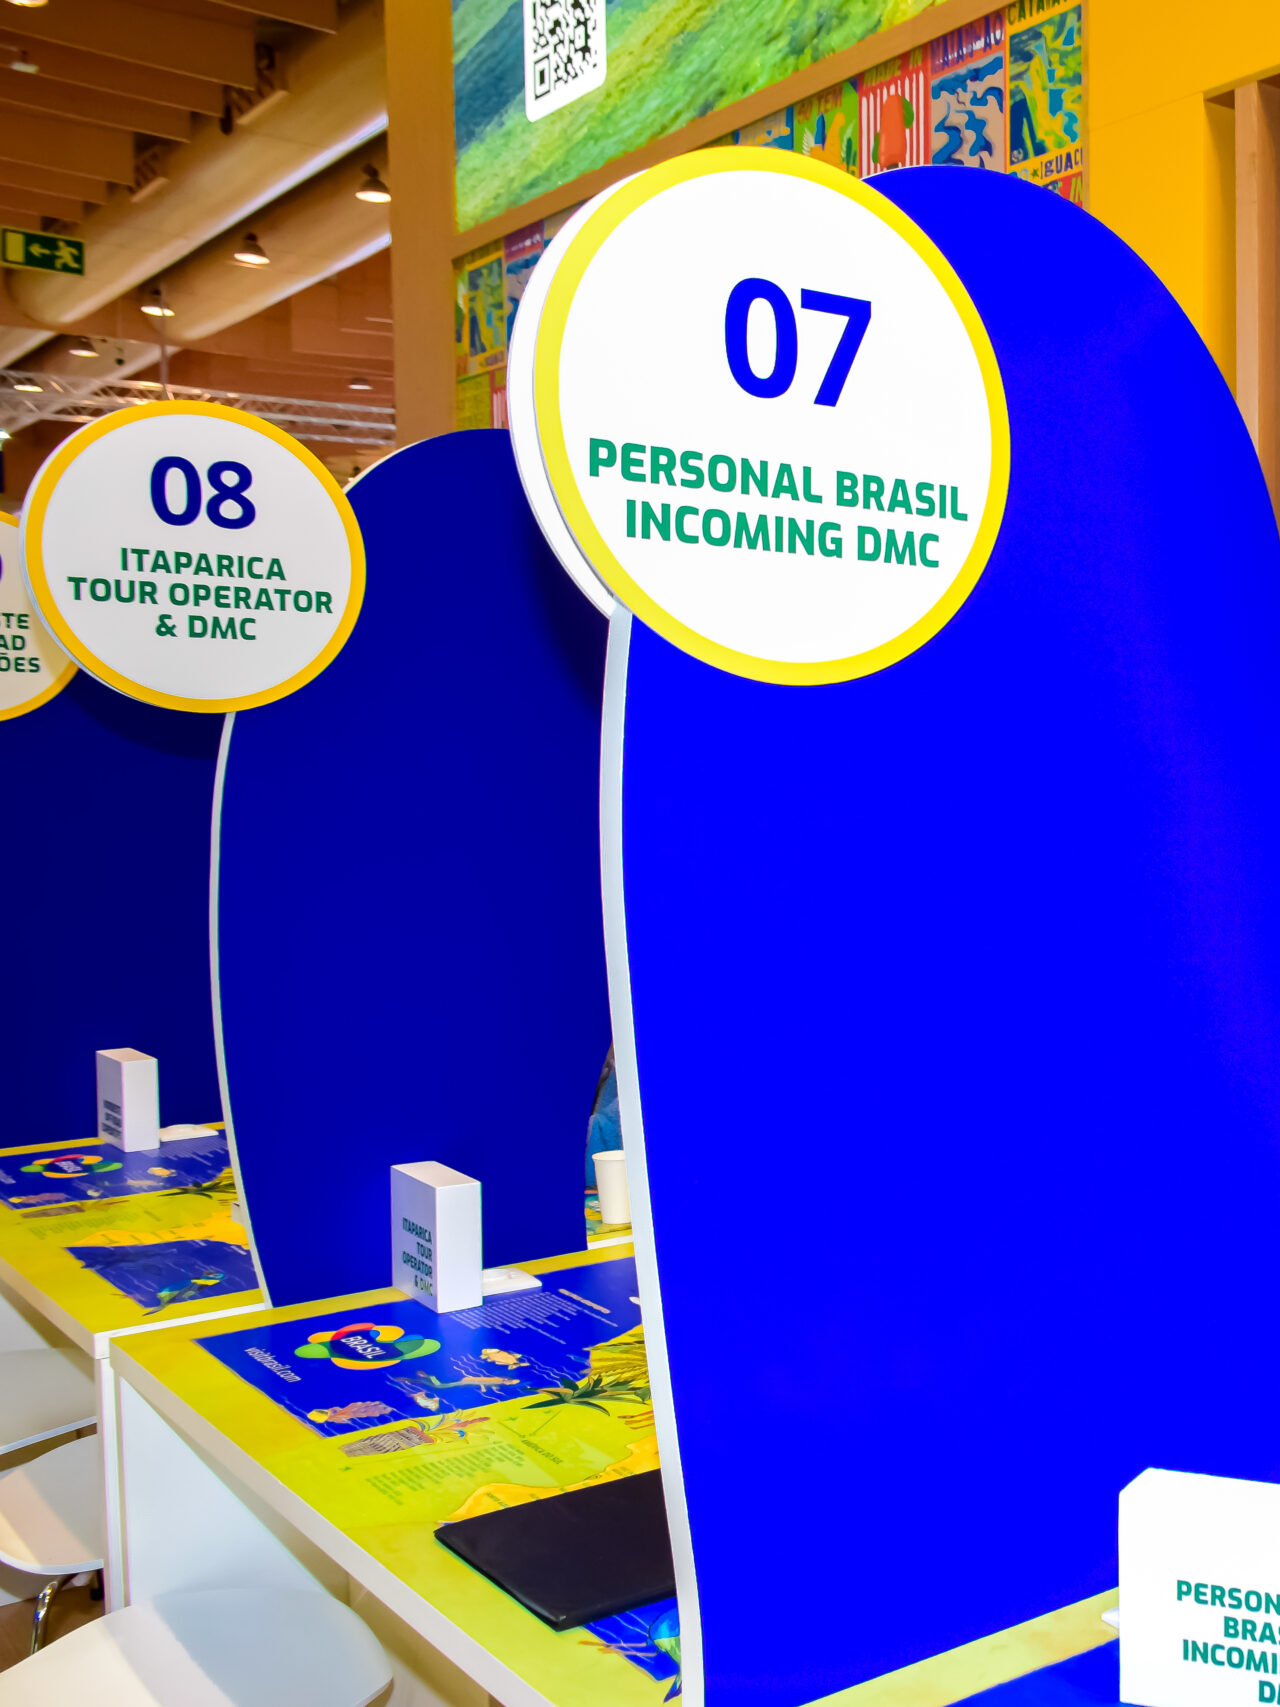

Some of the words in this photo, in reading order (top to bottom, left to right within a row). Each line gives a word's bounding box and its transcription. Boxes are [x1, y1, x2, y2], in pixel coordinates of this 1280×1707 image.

[725, 278, 871, 407] 07
[150, 456, 256, 529] 08
[590, 438, 822, 503] PERSONAL
[837, 471, 968, 521] BRASIL
[627, 500, 842, 558] INCOMING
[858, 526, 939, 568] DMC
[121, 547, 286, 580] ITAPARICA
[68, 576, 157, 604] TOUR
[169, 583, 332, 613] OPERATOR
[0, 612, 30, 629] TE
[156, 614, 177, 637] &
[188, 616, 256, 640] DMC
[402, 1217, 432, 1244] ITAPARICA
[402, 1250, 432, 1279] OPERATOR
[416, 1241, 432, 1262] TOUR
[420, 1277, 433, 1296] DMC
[340, 1335, 386, 1359] BRASIL
[244, 1346, 302, 1383] visitbrasil.com
